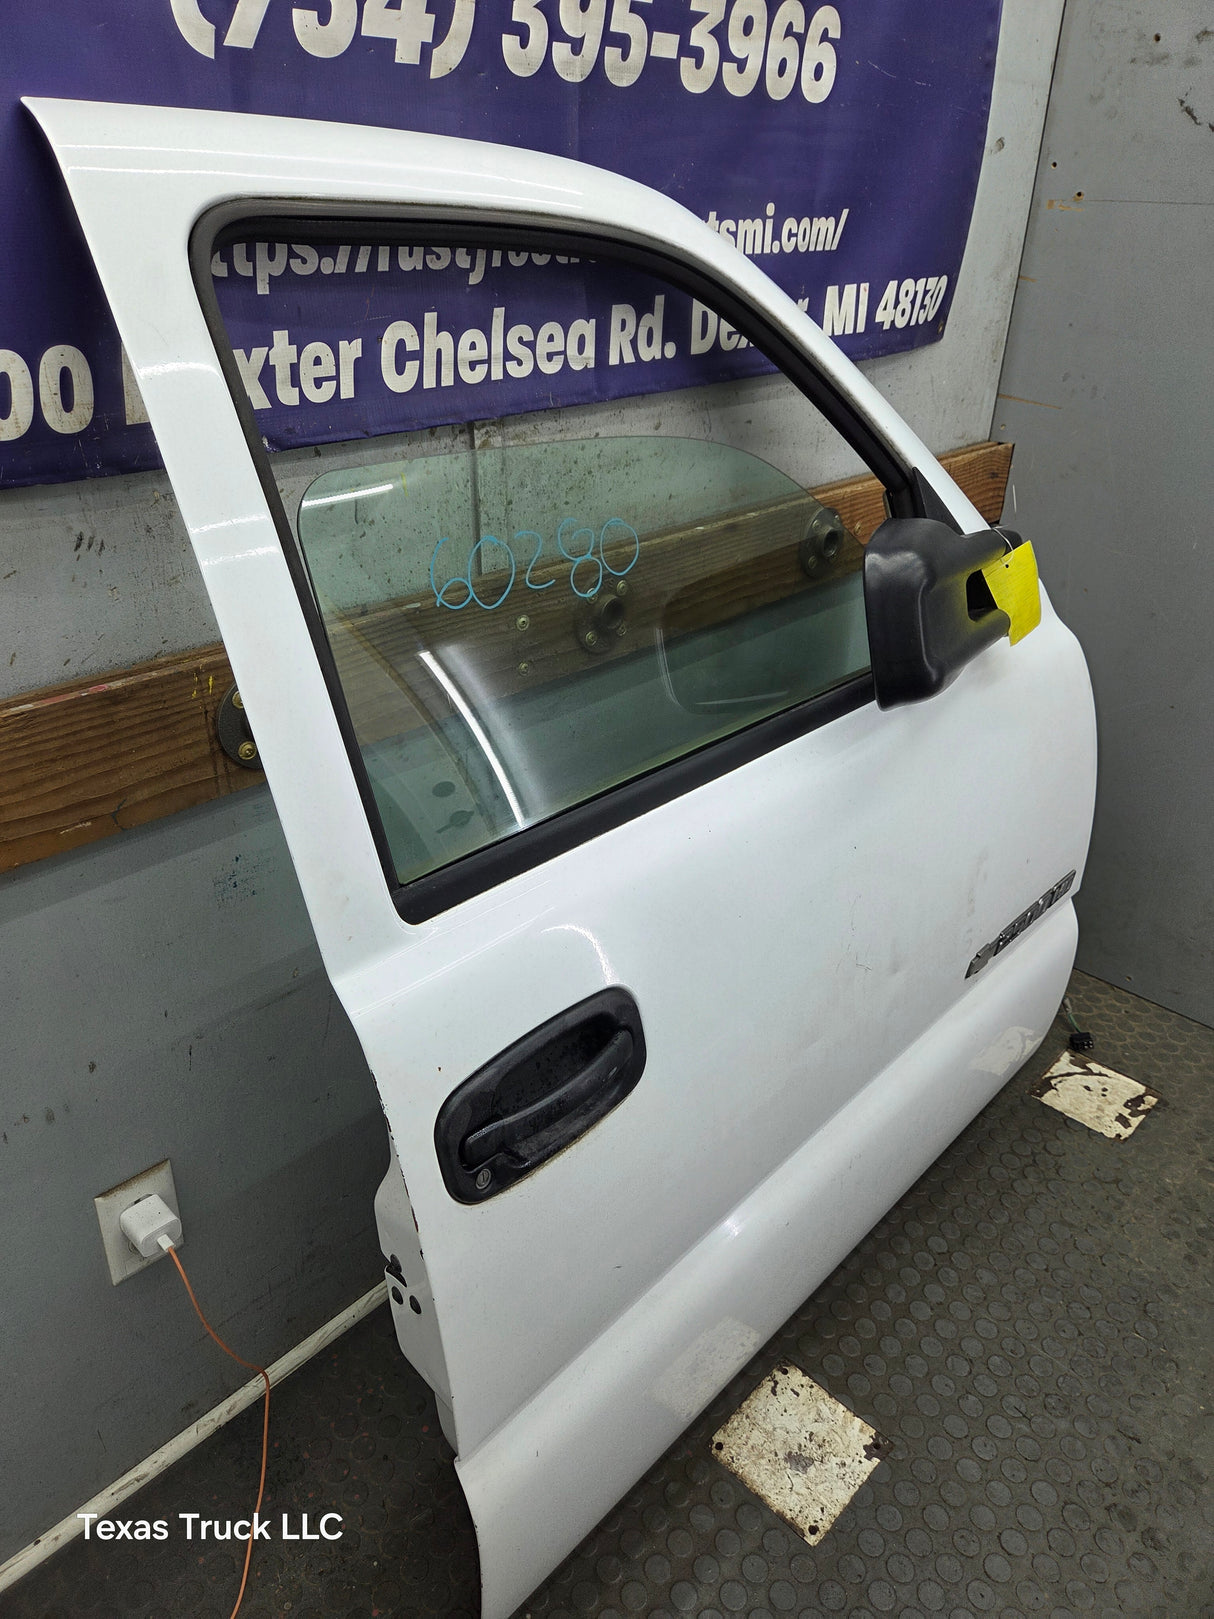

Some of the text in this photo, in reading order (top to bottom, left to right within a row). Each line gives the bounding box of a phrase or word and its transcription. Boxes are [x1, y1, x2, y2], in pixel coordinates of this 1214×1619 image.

[502, 0, 842, 103] 395-3966
[381, 306, 596, 393] Chelsea
[608, 294, 676, 366] Rd.
[822, 283, 869, 336] MI
[875, 275, 948, 330] 48130
[430, 518, 639, 609] 60280
